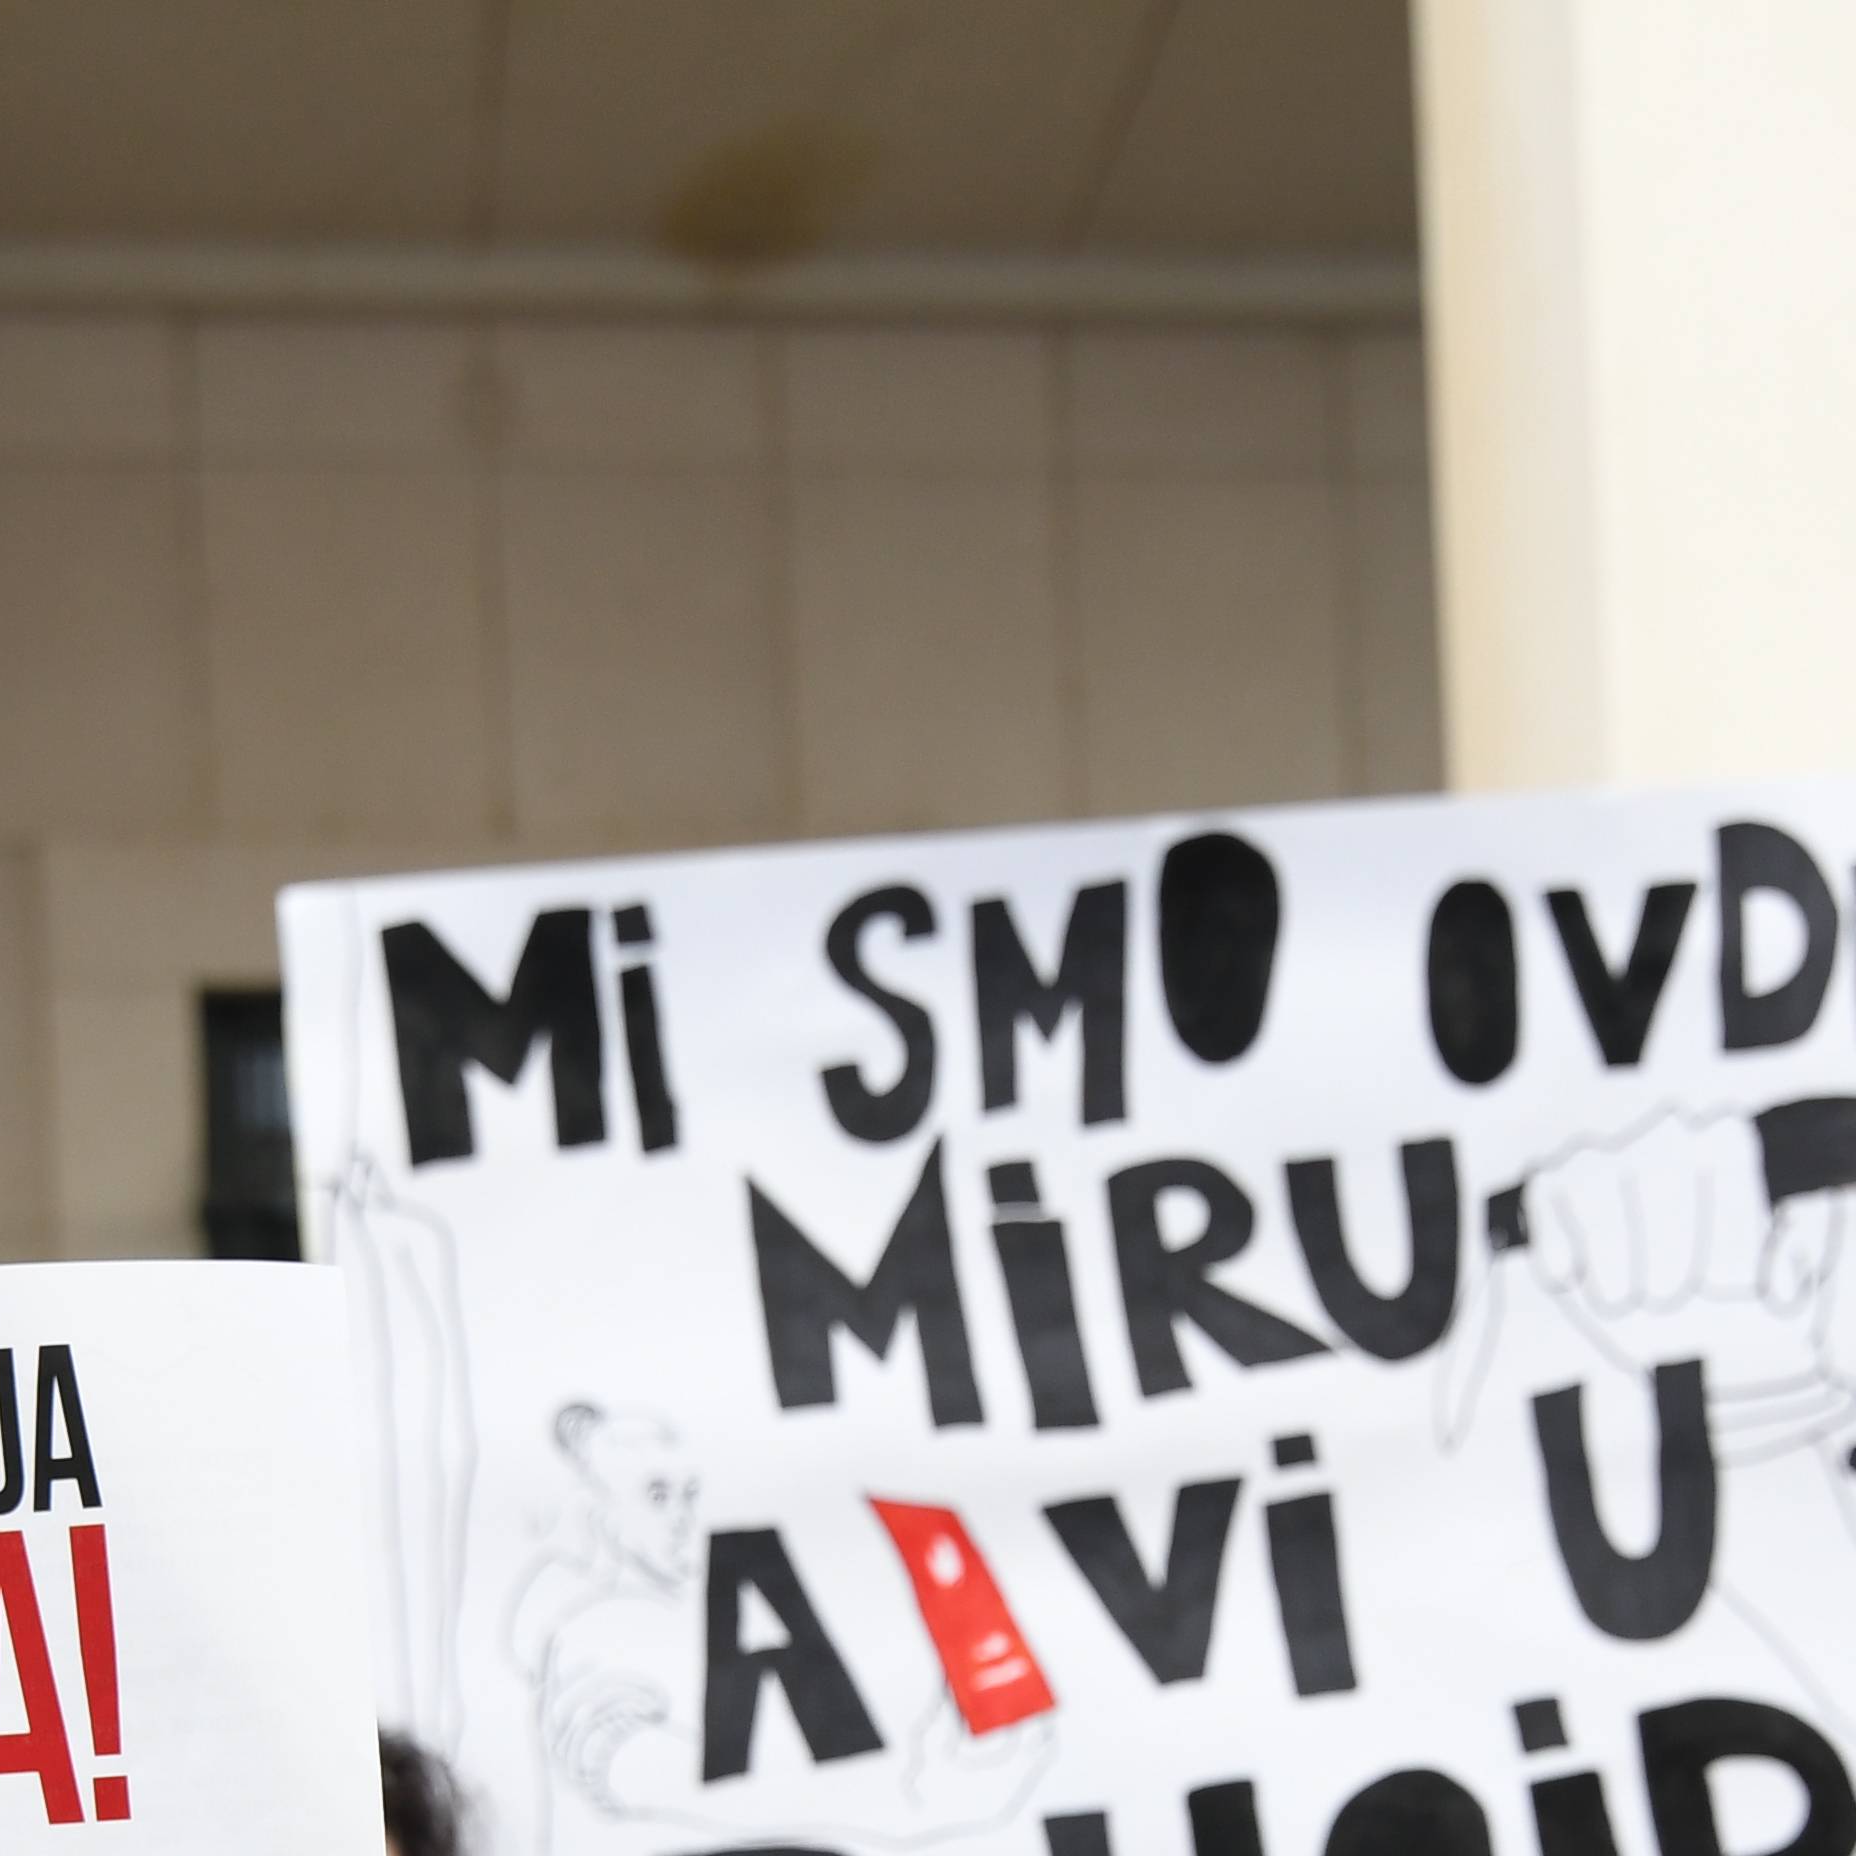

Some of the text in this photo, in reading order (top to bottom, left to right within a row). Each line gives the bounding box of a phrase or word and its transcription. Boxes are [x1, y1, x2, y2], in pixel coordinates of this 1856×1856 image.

[816, 830, 1284, 1148] SMO
[699, 1526, 886, 1786] A
[1531, 1358, 1718, 1642] U
